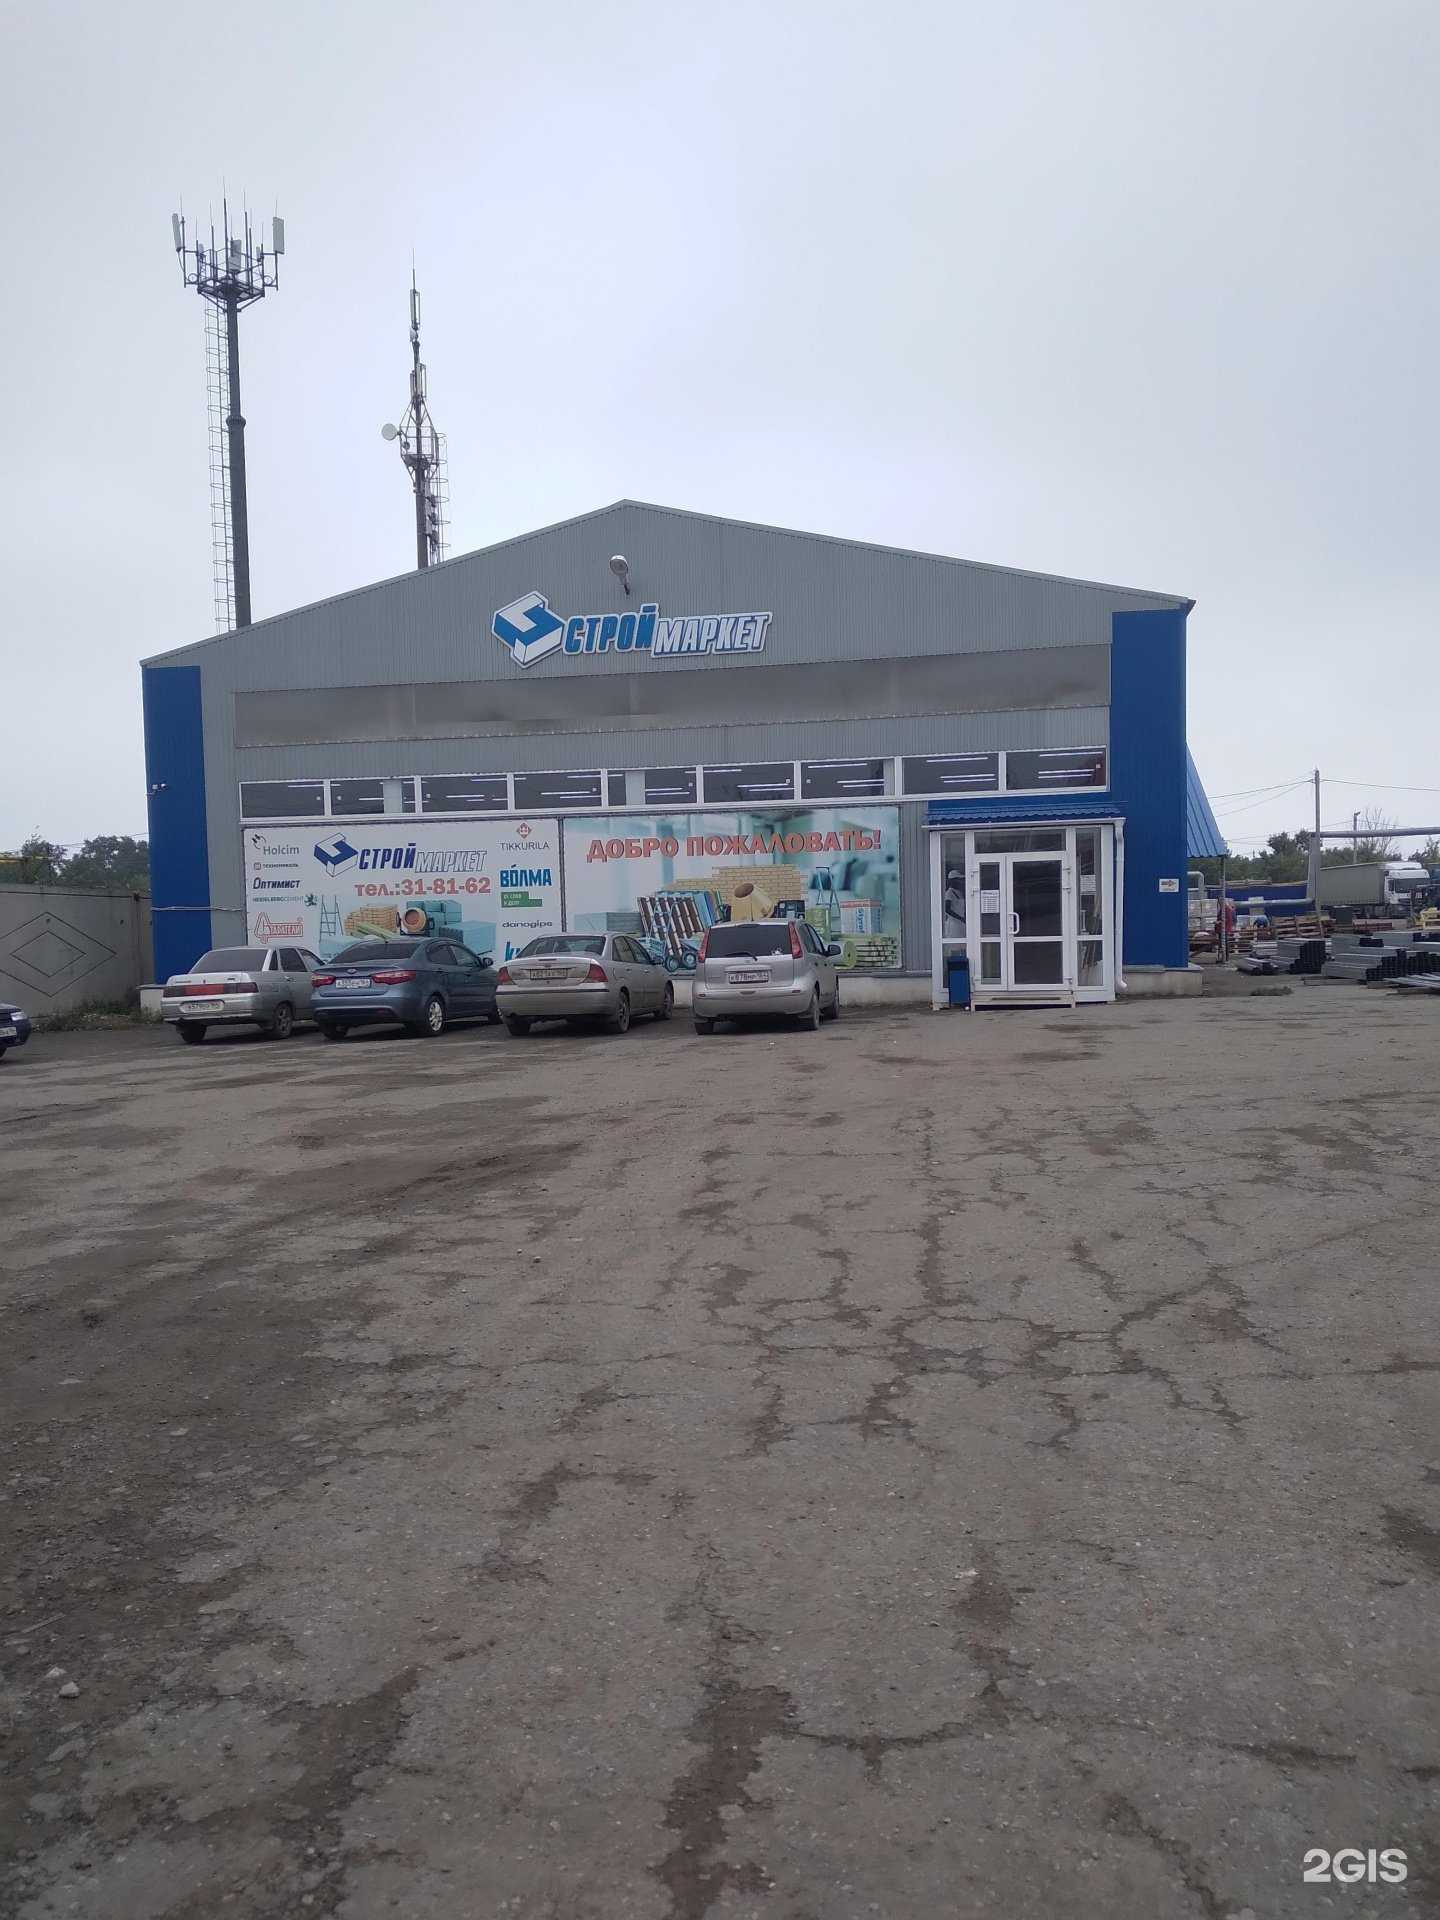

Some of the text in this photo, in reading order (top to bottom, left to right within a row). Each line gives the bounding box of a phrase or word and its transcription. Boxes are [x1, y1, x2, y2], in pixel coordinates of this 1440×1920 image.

[564, 603, 769, 655] СТРОЙМАРКЕТ
[263, 843, 299, 856] Holcim
[358, 843, 488, 873] СТРОЙМАРКЕТ
[500, 841, 550, 852] TIKKURILA
[586, 829, 881, 862] ДОБРО ПОЖАЛОВАТЬ!
